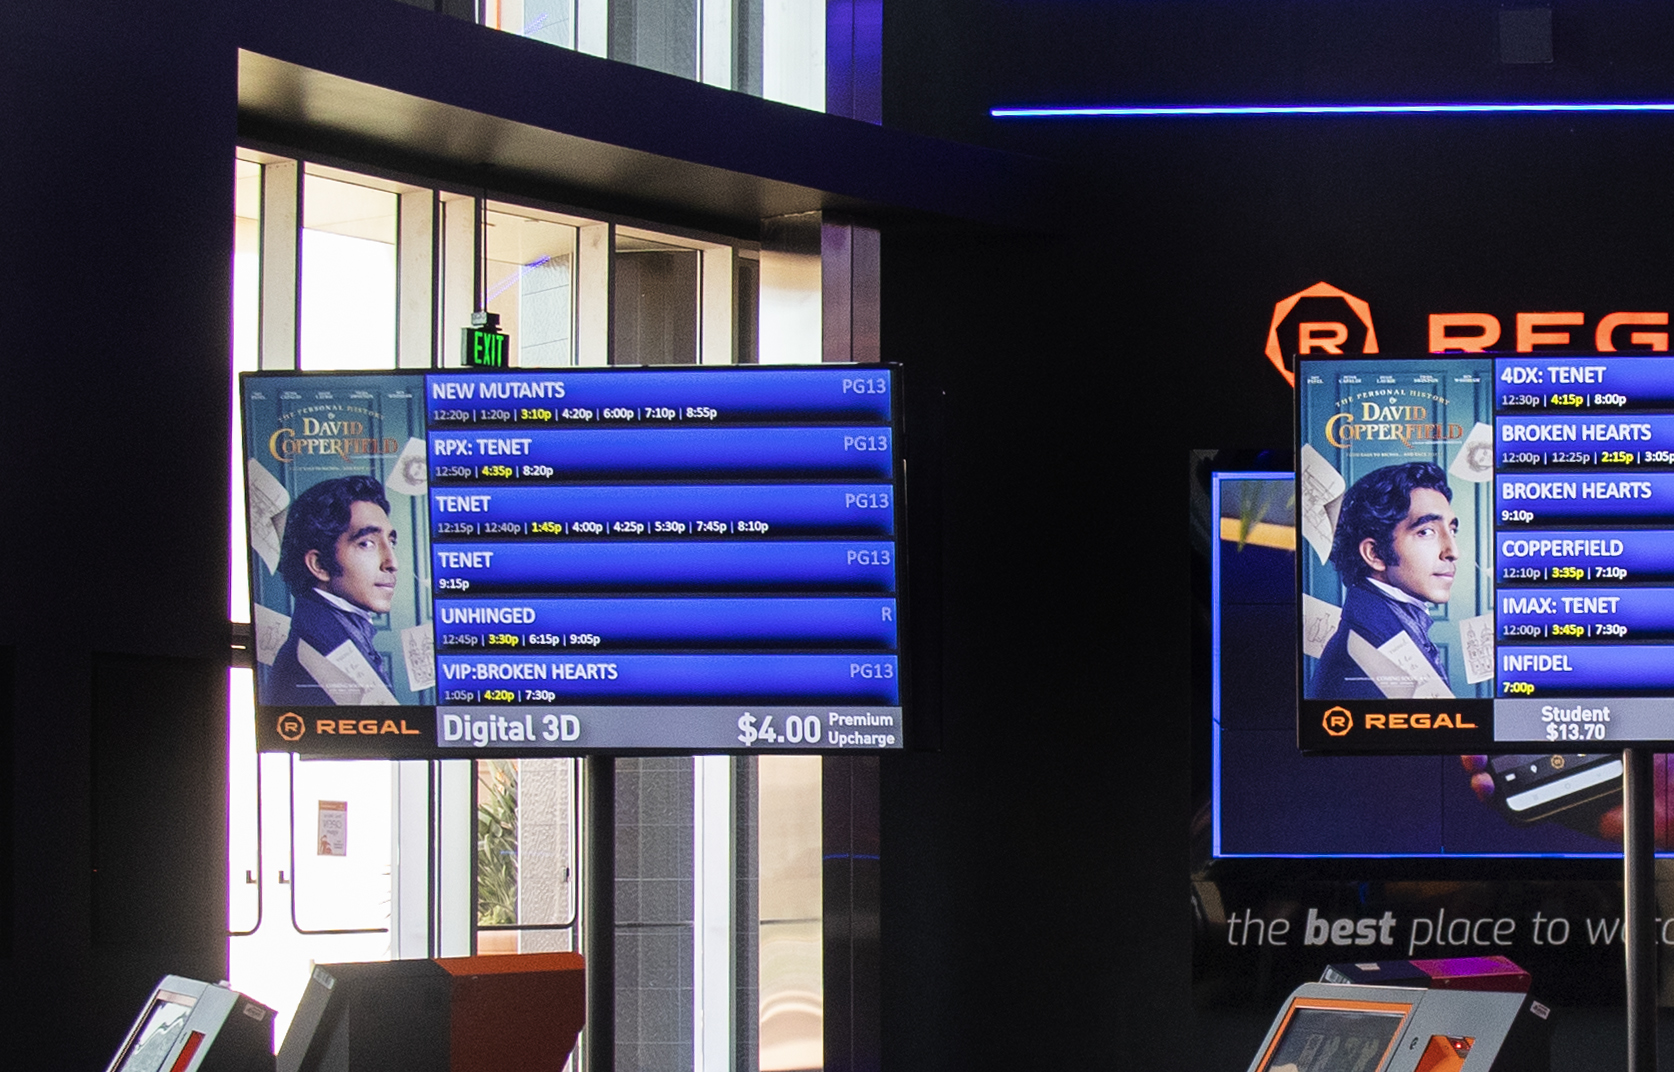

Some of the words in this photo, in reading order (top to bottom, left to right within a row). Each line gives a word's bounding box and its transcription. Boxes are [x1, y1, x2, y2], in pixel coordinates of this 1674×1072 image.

[474, 331, 504, 367] EXIT
[1501, 367, 1544, 384] 4DX:
[1547, 366, 1606, 383] TENET
[432, 383, 474, 399] NEW
[479, 382, 565, 398] MUTANTS
[842, 379, 886, 394] PG13
[1502, 395, 1540, 407] 12:30p
[1550, 394, 1583, 406] 4:15p
[1594, 394, 1627, 406] 8:00p
[434, 410, 469, 421] 12:20p
[481, 410, 510, 421] 1:20p
[521, 409, 551, 421] 3:10p
[562, 409, 593, 420] 4:20p
[603, 408, 634, 420] 6:00p
[645, 408, 675, 420] 7:10p
[686, 407, 717, 420] 8:55p
[1362, 402, 1427, 421] DAVID
[303, 418, 363, 436] DAVID
[1325, 413, 1463, 448] COPPERFIELD
[1502, 424, 1576, 442] BROKEN
[1582, 424, 1652, 441] HEARTS
[434, 439, 473, 456] RPX:
[476, 439, 532, 455] TENET
[844, 436, 887, 451] PG13
[1502, 452, 1540, 464] 12:00p
[1552, 452, 1590, 464] 12:25p
[1601, 451, 1634, 464] 2:15p
[435, 467, 471, 478] 12:50p
[481, 466, 512, 478] 4:35p
[523, 465, 553, 477] 8:20p
[1502, 482, 1577, 500] BROKEN
[1582, 482, 1652, 499] HEARTS
[435, 496, 491, 512] TENET
[845, 493, 889, 508] PG13
[1502, 510, 1534, 523] 9:10p
[438, 523, 473, 534] 12:15p
[484, 523, 520, 534] 12:40p
[531, 523, 562, 534] 1:45p
[572, 522, 603, 533] 4:00p
[613, 522, 644, 533] 4:25p
[654, 522, 685, 533] 5:30p
[696, 521, 727, 533] 7:45p
[737, 521, 769, 534] 8:10p
[1502, 539, 1624, 557] COPPERFIELD
[438, 552, 493, 568] TENET
[847, 550, 890, 565] PG13
[1503, 567, 1541, 580] 12:10p
[1552, 567, 1584, 580] 3:35p
[1595, 567, 1627, 579] 7:10p
[439, 579, 469, 590] 9:15p
[1503, 597, 1557, 614] IMAX:
[1561, 596, 1620, 614] TENET
[441, 608, 536, 624] UNHINGED
[881, 607, 892, 621] R
[1503, 625, 1541, 637] 12:00p
[1552, 624, 1584, 637] 3:45p
[1595, 624, 1627, 637] 7:30p
[443, 635, 478, 646] 12:45p
[488, 634, 519, 646] 3:30p
[529, 634, 559, 646] 6:15p
[569, 634, 600, 645] 9:05p
[443, 664, 547, 680] VIP:BROKEN
[551, 663, 618, 680] HEARTS
[850, 663, 893, 679] PG13
[1503, 655, 1573, 672] INFIDEL
[445, 691, 474, 702] 1:05p
[484, 690, 515, 702] 4:20p
[525, 690, 555, 702] 7:30p
[1503, 682, 1535, 695] 7:00p
[828, 712, 893, 726] Premium
[1365, 713, 1477, 729] REGAL
[1541, 706, 1610, 723] Student
[316, 719, 421, 734] REGAL
[443, 714, 536, 747] Digital
[542, 715, 580, 741] 3D
[737, 712, 821, 746] $4.00
[1546, 722, 1606, 742] $13.70
[828, 731, 895, 747] Upcharge
[1226, 909, 1290, 947] the
[1304, 908, 1397, 947] best
[1409, 909, 1515, 956] place
[1532, 912, 1571, 946] to
